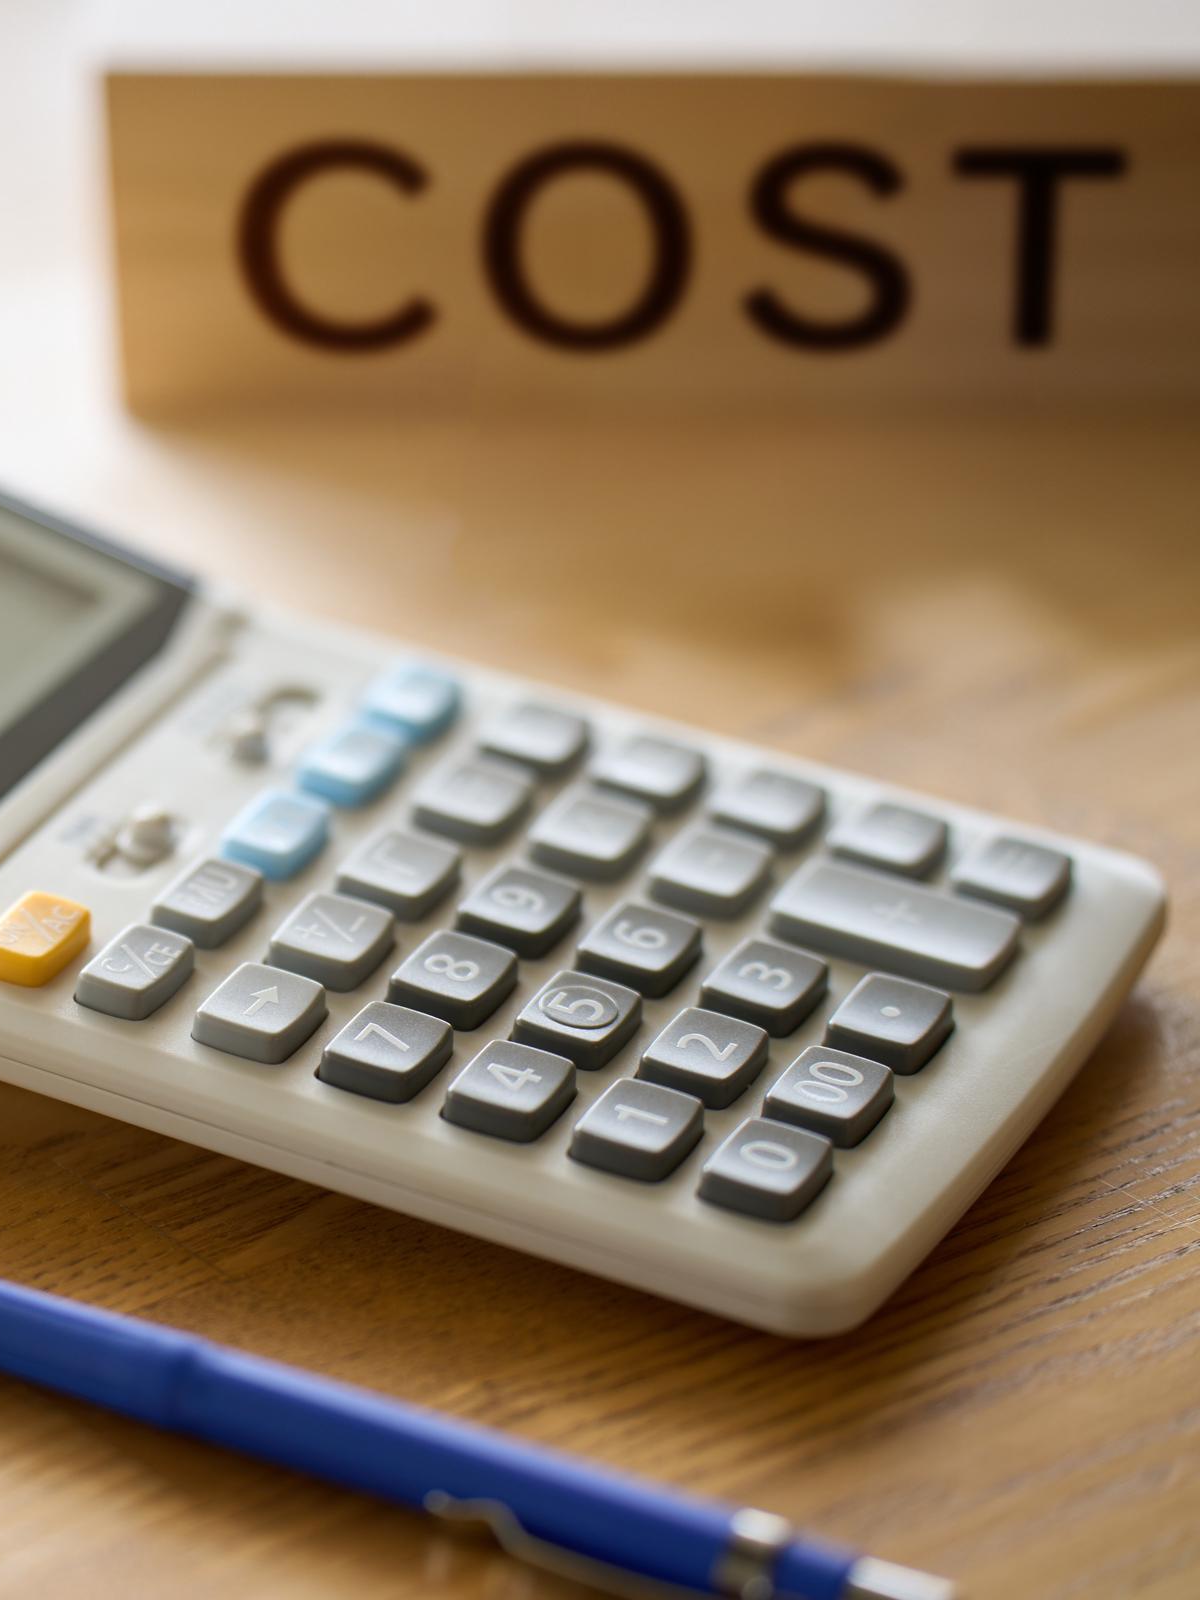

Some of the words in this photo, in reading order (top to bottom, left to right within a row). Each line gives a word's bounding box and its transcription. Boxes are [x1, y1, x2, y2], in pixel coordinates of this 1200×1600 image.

[234, 136, 1128, 356] COST
[490, 884, 545, 912] 9
[612, 920, 667, 951] 6
[423, 953, 482, 983] 8
[737, 961, 794, 992] 3
[544, 988, 604, 1024] 5
[353, 1022, 411, 1054] 7
[674, 1033, 739, 1063] 2
[485, 1060, 544, 1092] 4
[792, 1061, 865, 1104] 00
[613, 1103, 671, 1129] 1
[739, 1139, 799, 1170] 0
